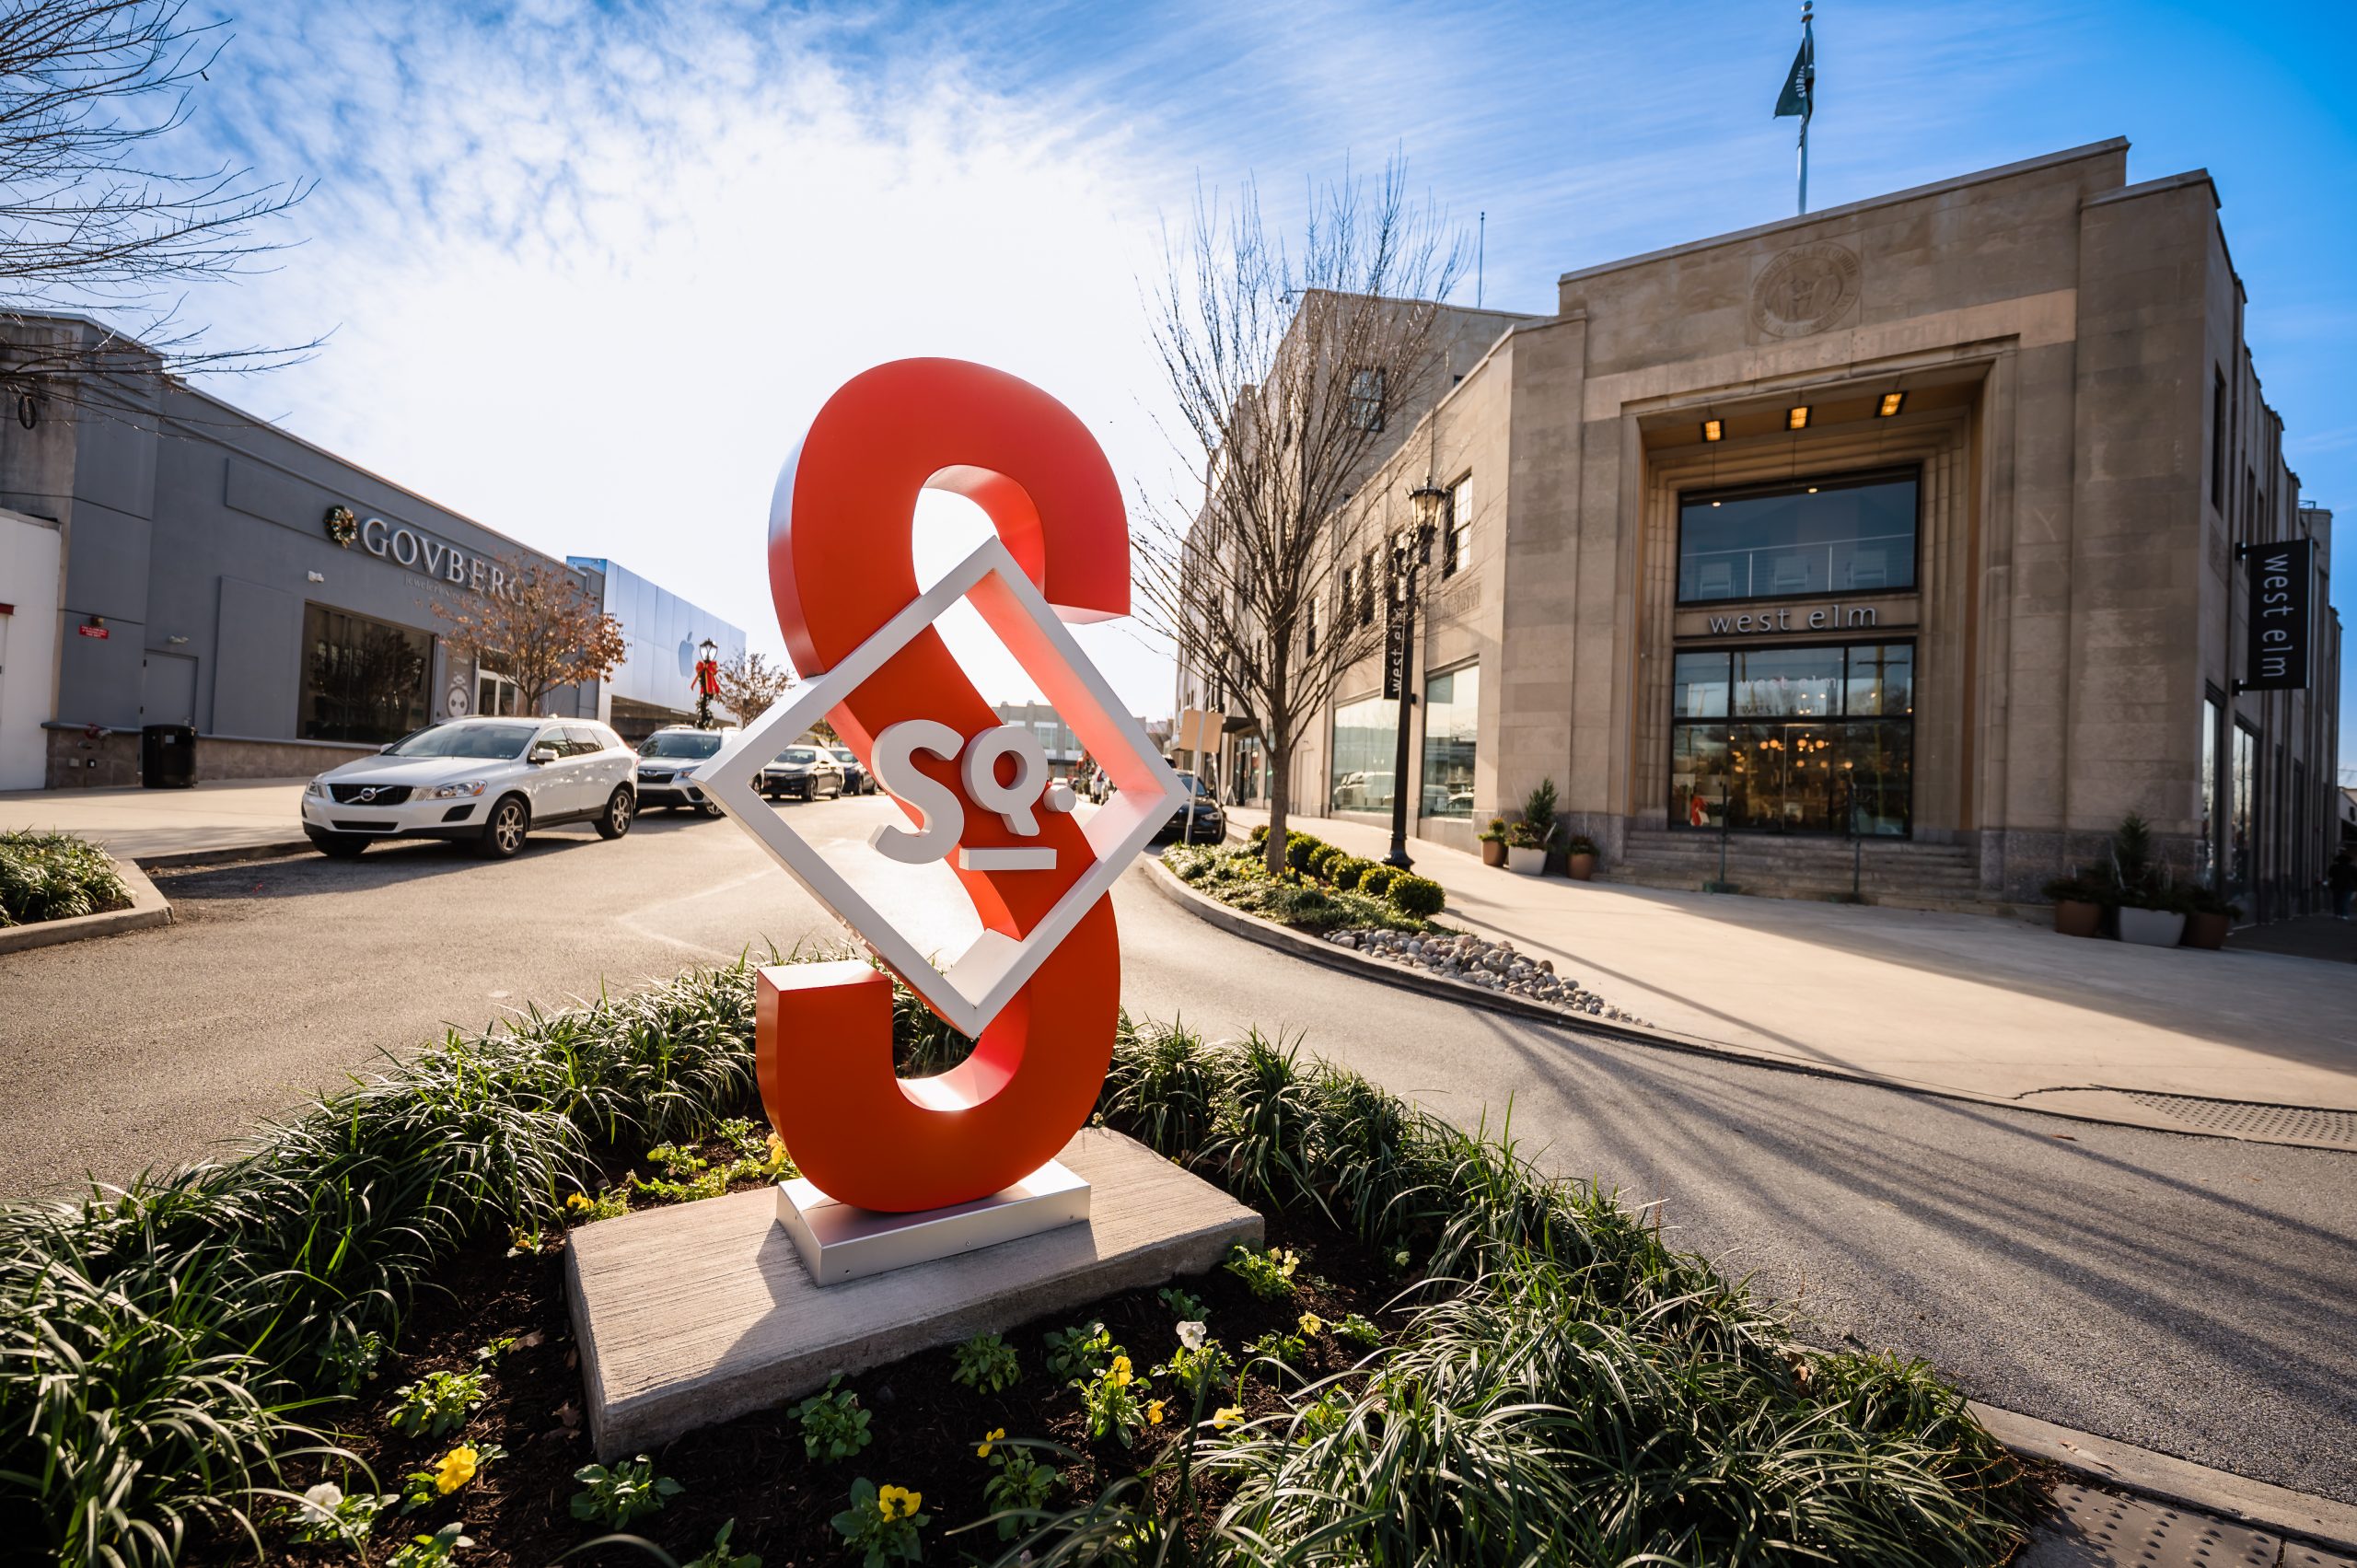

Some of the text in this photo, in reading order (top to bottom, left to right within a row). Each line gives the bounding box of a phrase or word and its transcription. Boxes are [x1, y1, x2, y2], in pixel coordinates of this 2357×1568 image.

[359, 517, 524, 607] GOVBERG
[1710, 604, 1876, 634] west elm
[2261, 553, 2294, 678] west elm
[1392, 647, 1402, 692] west
[1739, 675, 1837, 691] west elm
